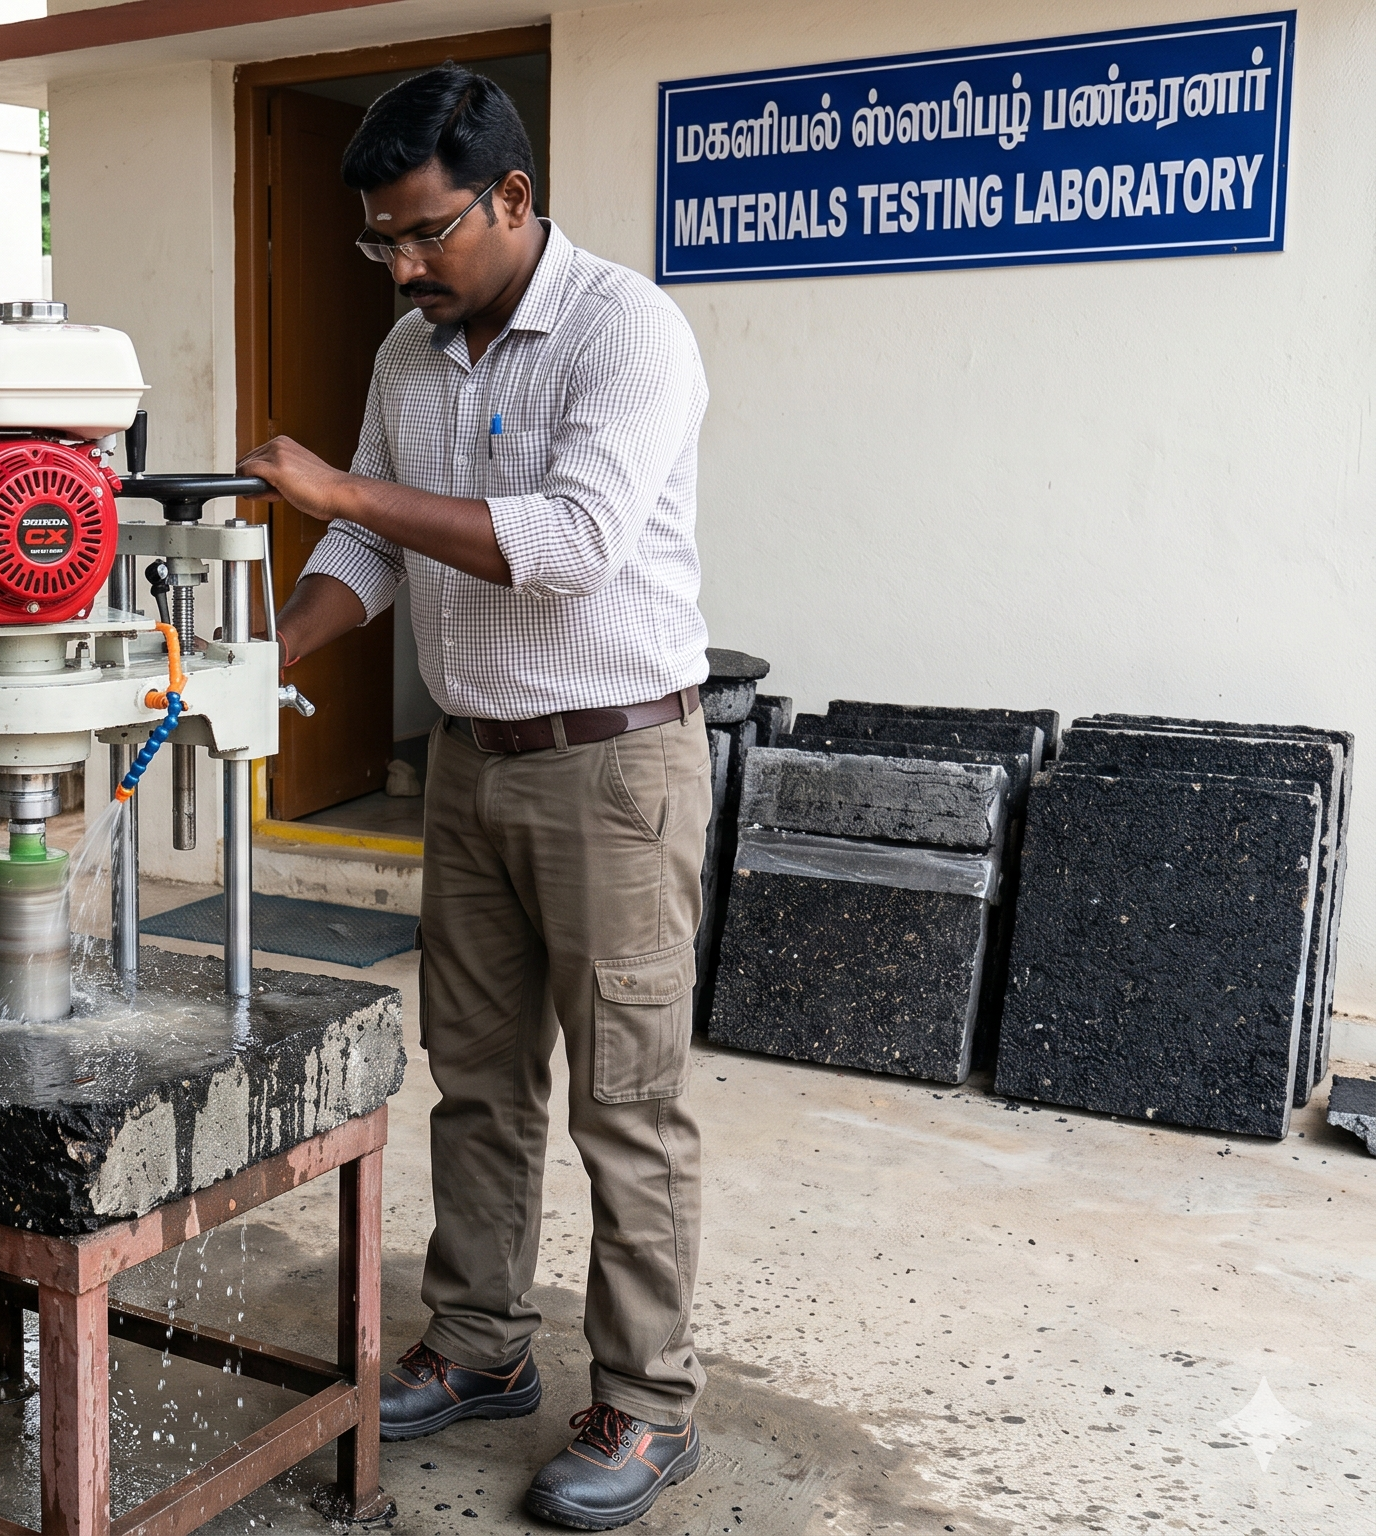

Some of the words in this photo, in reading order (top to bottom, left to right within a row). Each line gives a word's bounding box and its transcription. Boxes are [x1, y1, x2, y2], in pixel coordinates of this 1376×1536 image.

[674, 186, 848, 247] MATERIALS
[857, 174, 1003, 235] TESTING
[1014, 153, 1264, 225] LABORATORY
